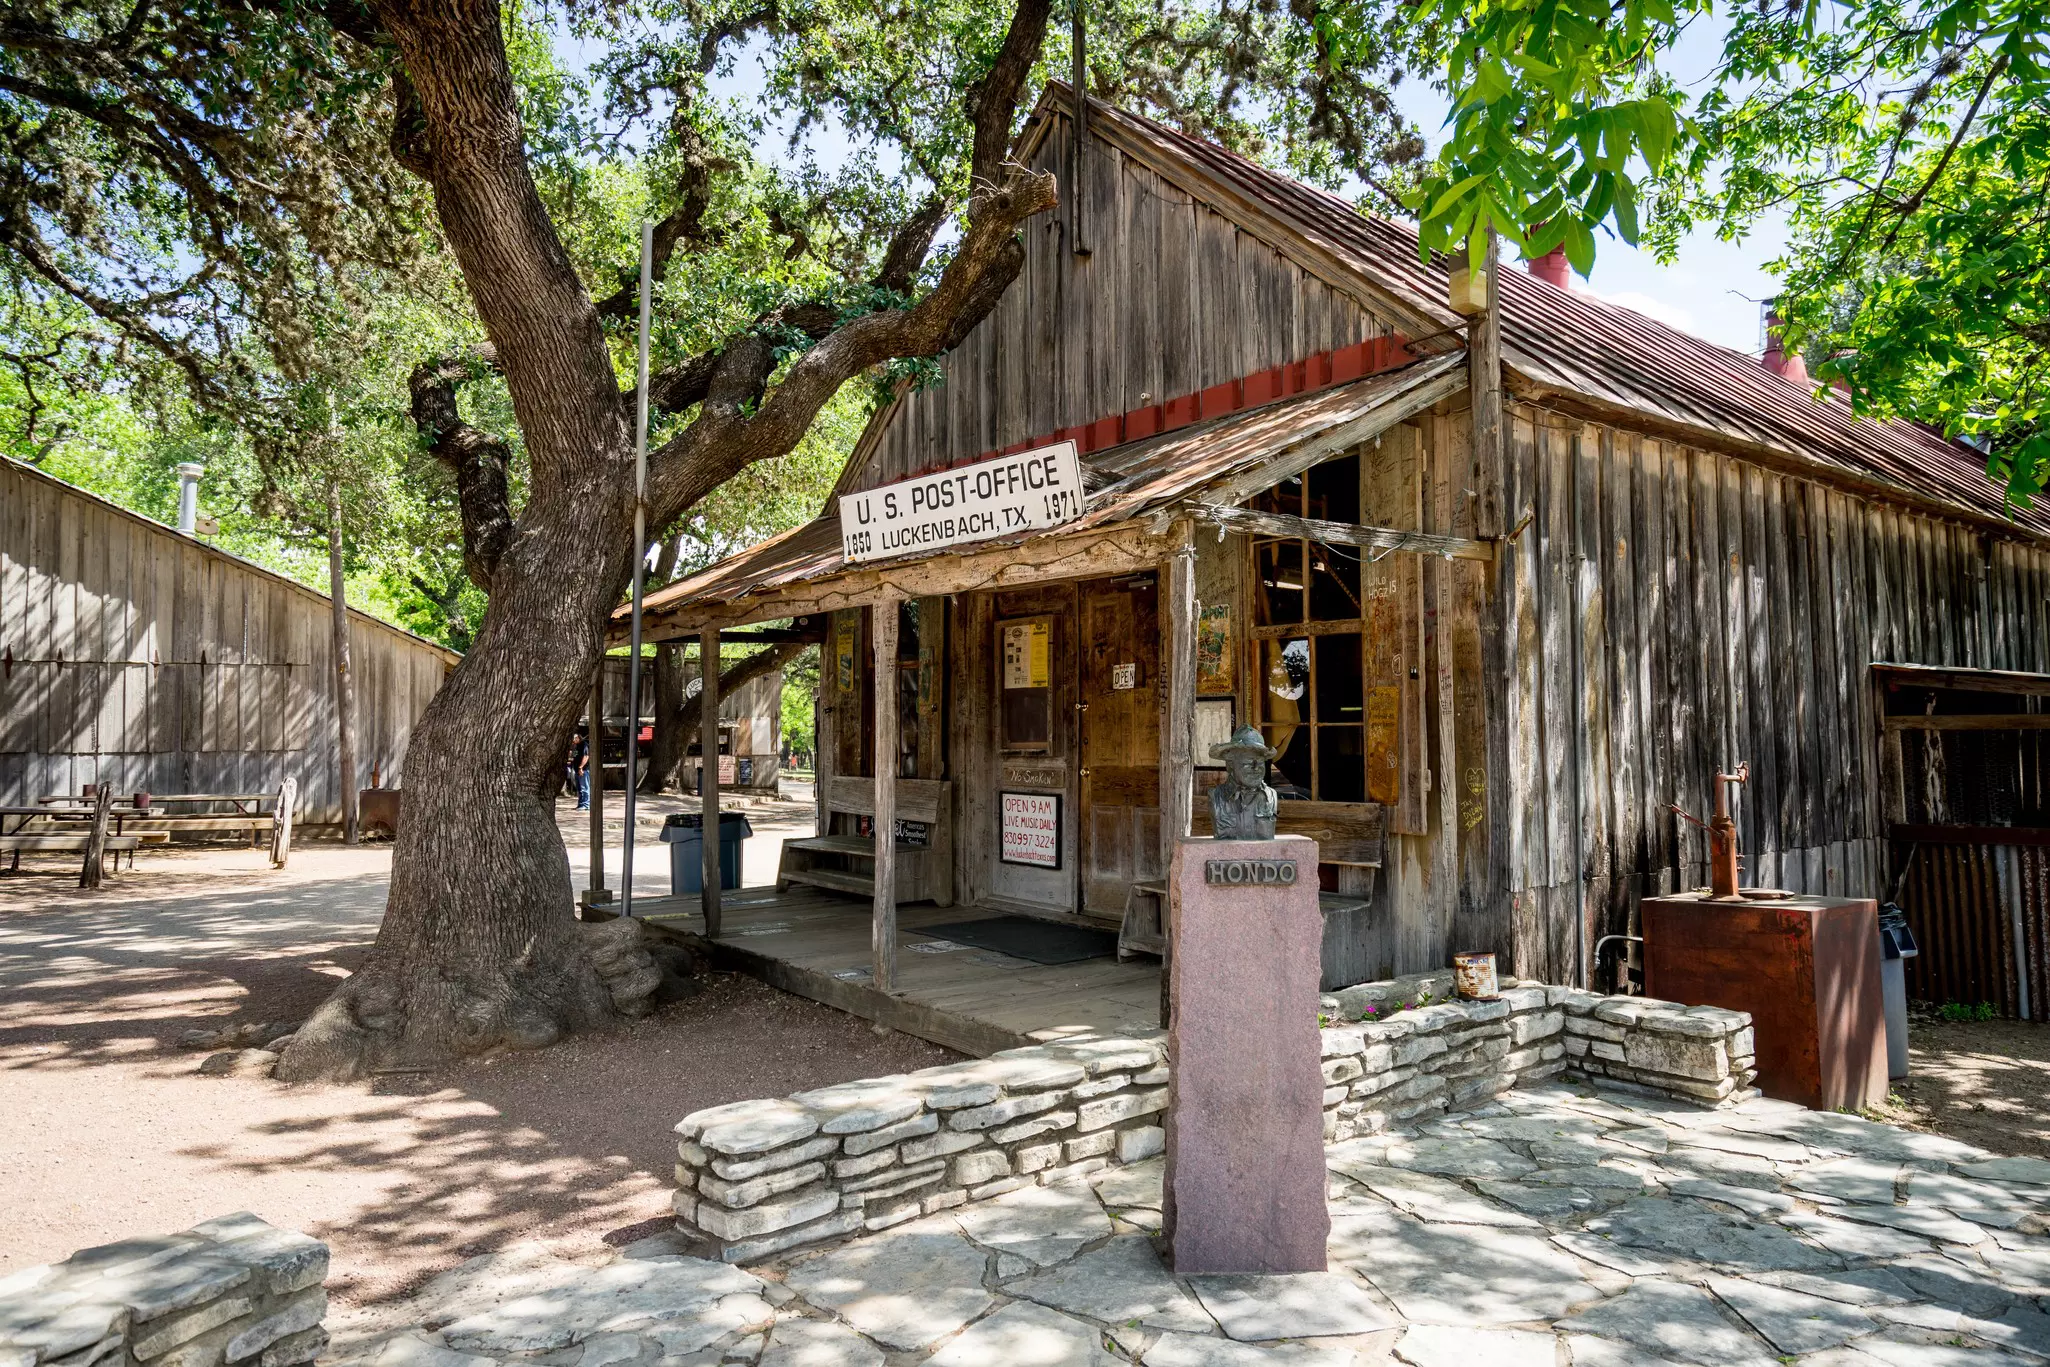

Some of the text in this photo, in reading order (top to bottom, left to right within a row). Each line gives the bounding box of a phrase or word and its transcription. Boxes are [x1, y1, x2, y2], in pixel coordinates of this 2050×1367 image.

[857, 456, 1060, 525] U. S. POST-OFFICE
[846, 490, 1078, 556] 1850 LUCKENBACH, TX, 1971
[1115, 670, 1134, 684] OPEN
[1005, 798, 1052, 815] OPEN 9 AM
[1004, 815, 1056, 831] LIVE MUSIC DAILY
[1035, 834, 1055, 849] 3224
[1210, 863, 1295, 883] HONDO
